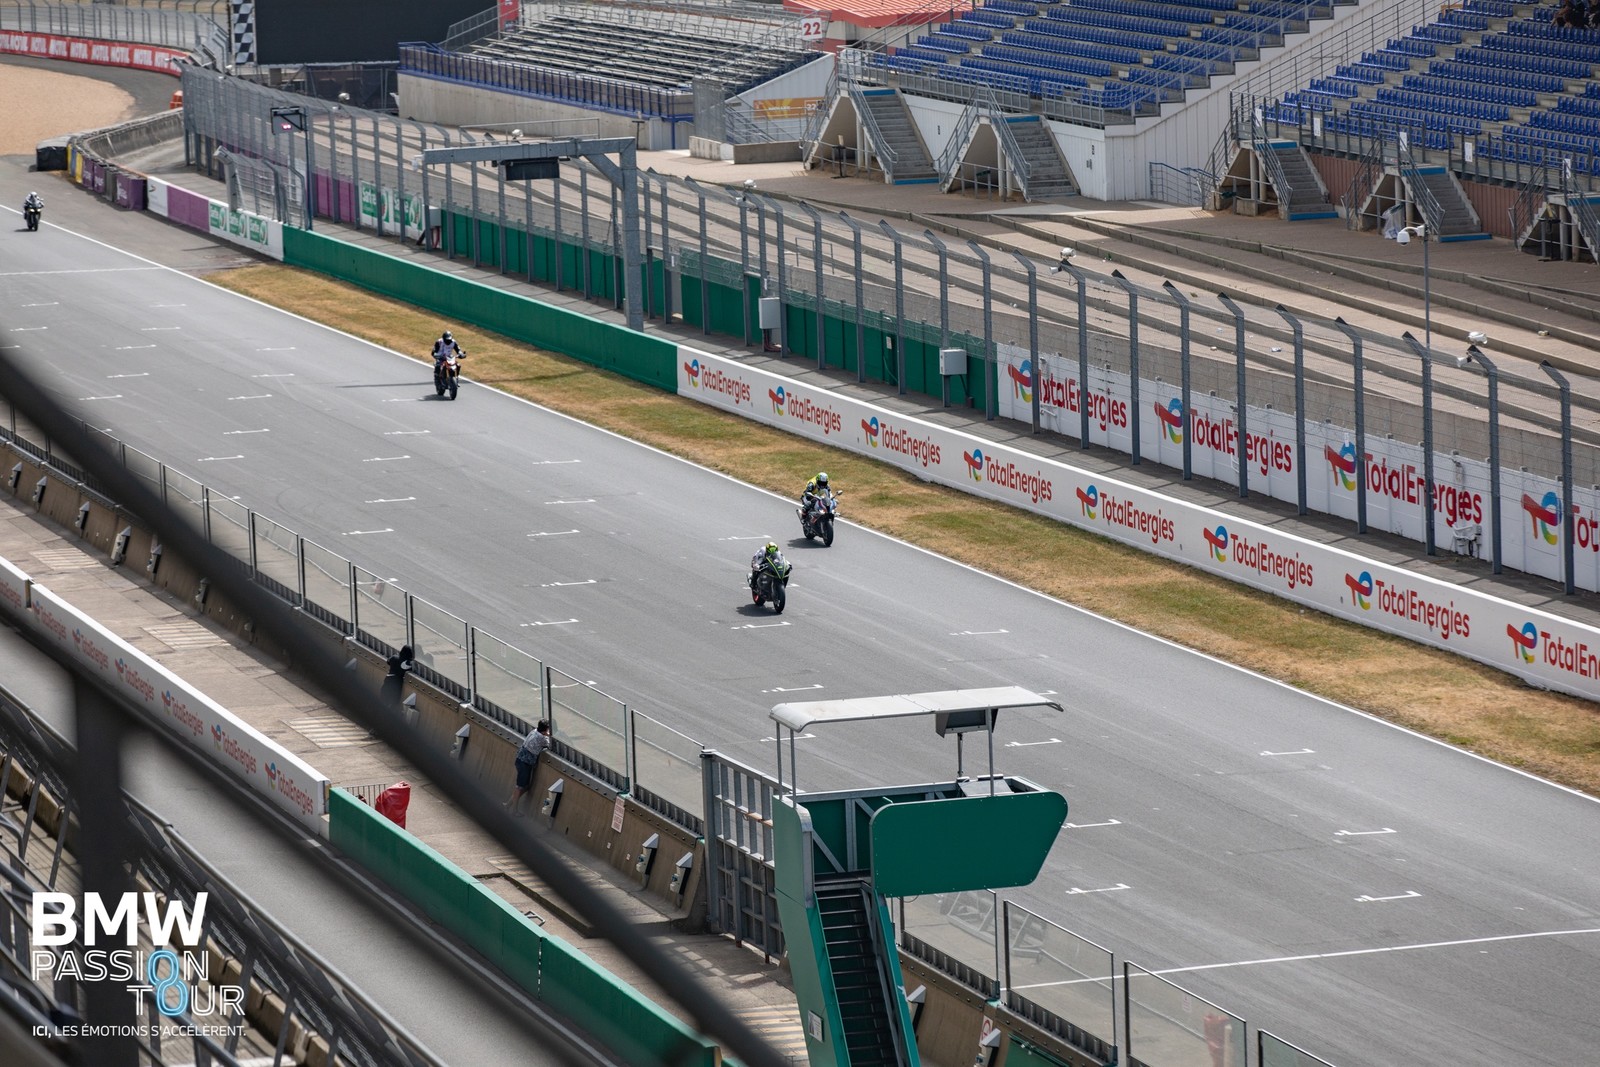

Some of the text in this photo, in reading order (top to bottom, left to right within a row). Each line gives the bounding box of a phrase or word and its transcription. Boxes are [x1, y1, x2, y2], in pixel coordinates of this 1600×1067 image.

[803, 22, 821, 36] 22
[700, 364, 751, 404] TotalEnergies
[786, 392, 841, 434] TotalEnergies
[880, 423, 941, 467] TotalEnergies
[984, 455, 1053, 503] TotalEnergies
[1100, 492, 1174, 543] TotalEnergies
[1230, 533, 1313, 589] TotalEnergies
[1375, 579, 1471, 640] TotalEnergies
[1540, 630, 1600, 680] TotalEn
[222, 731, 257, 774] TotalEnergies
[277, 769, 313, 815] TotalEnergies
